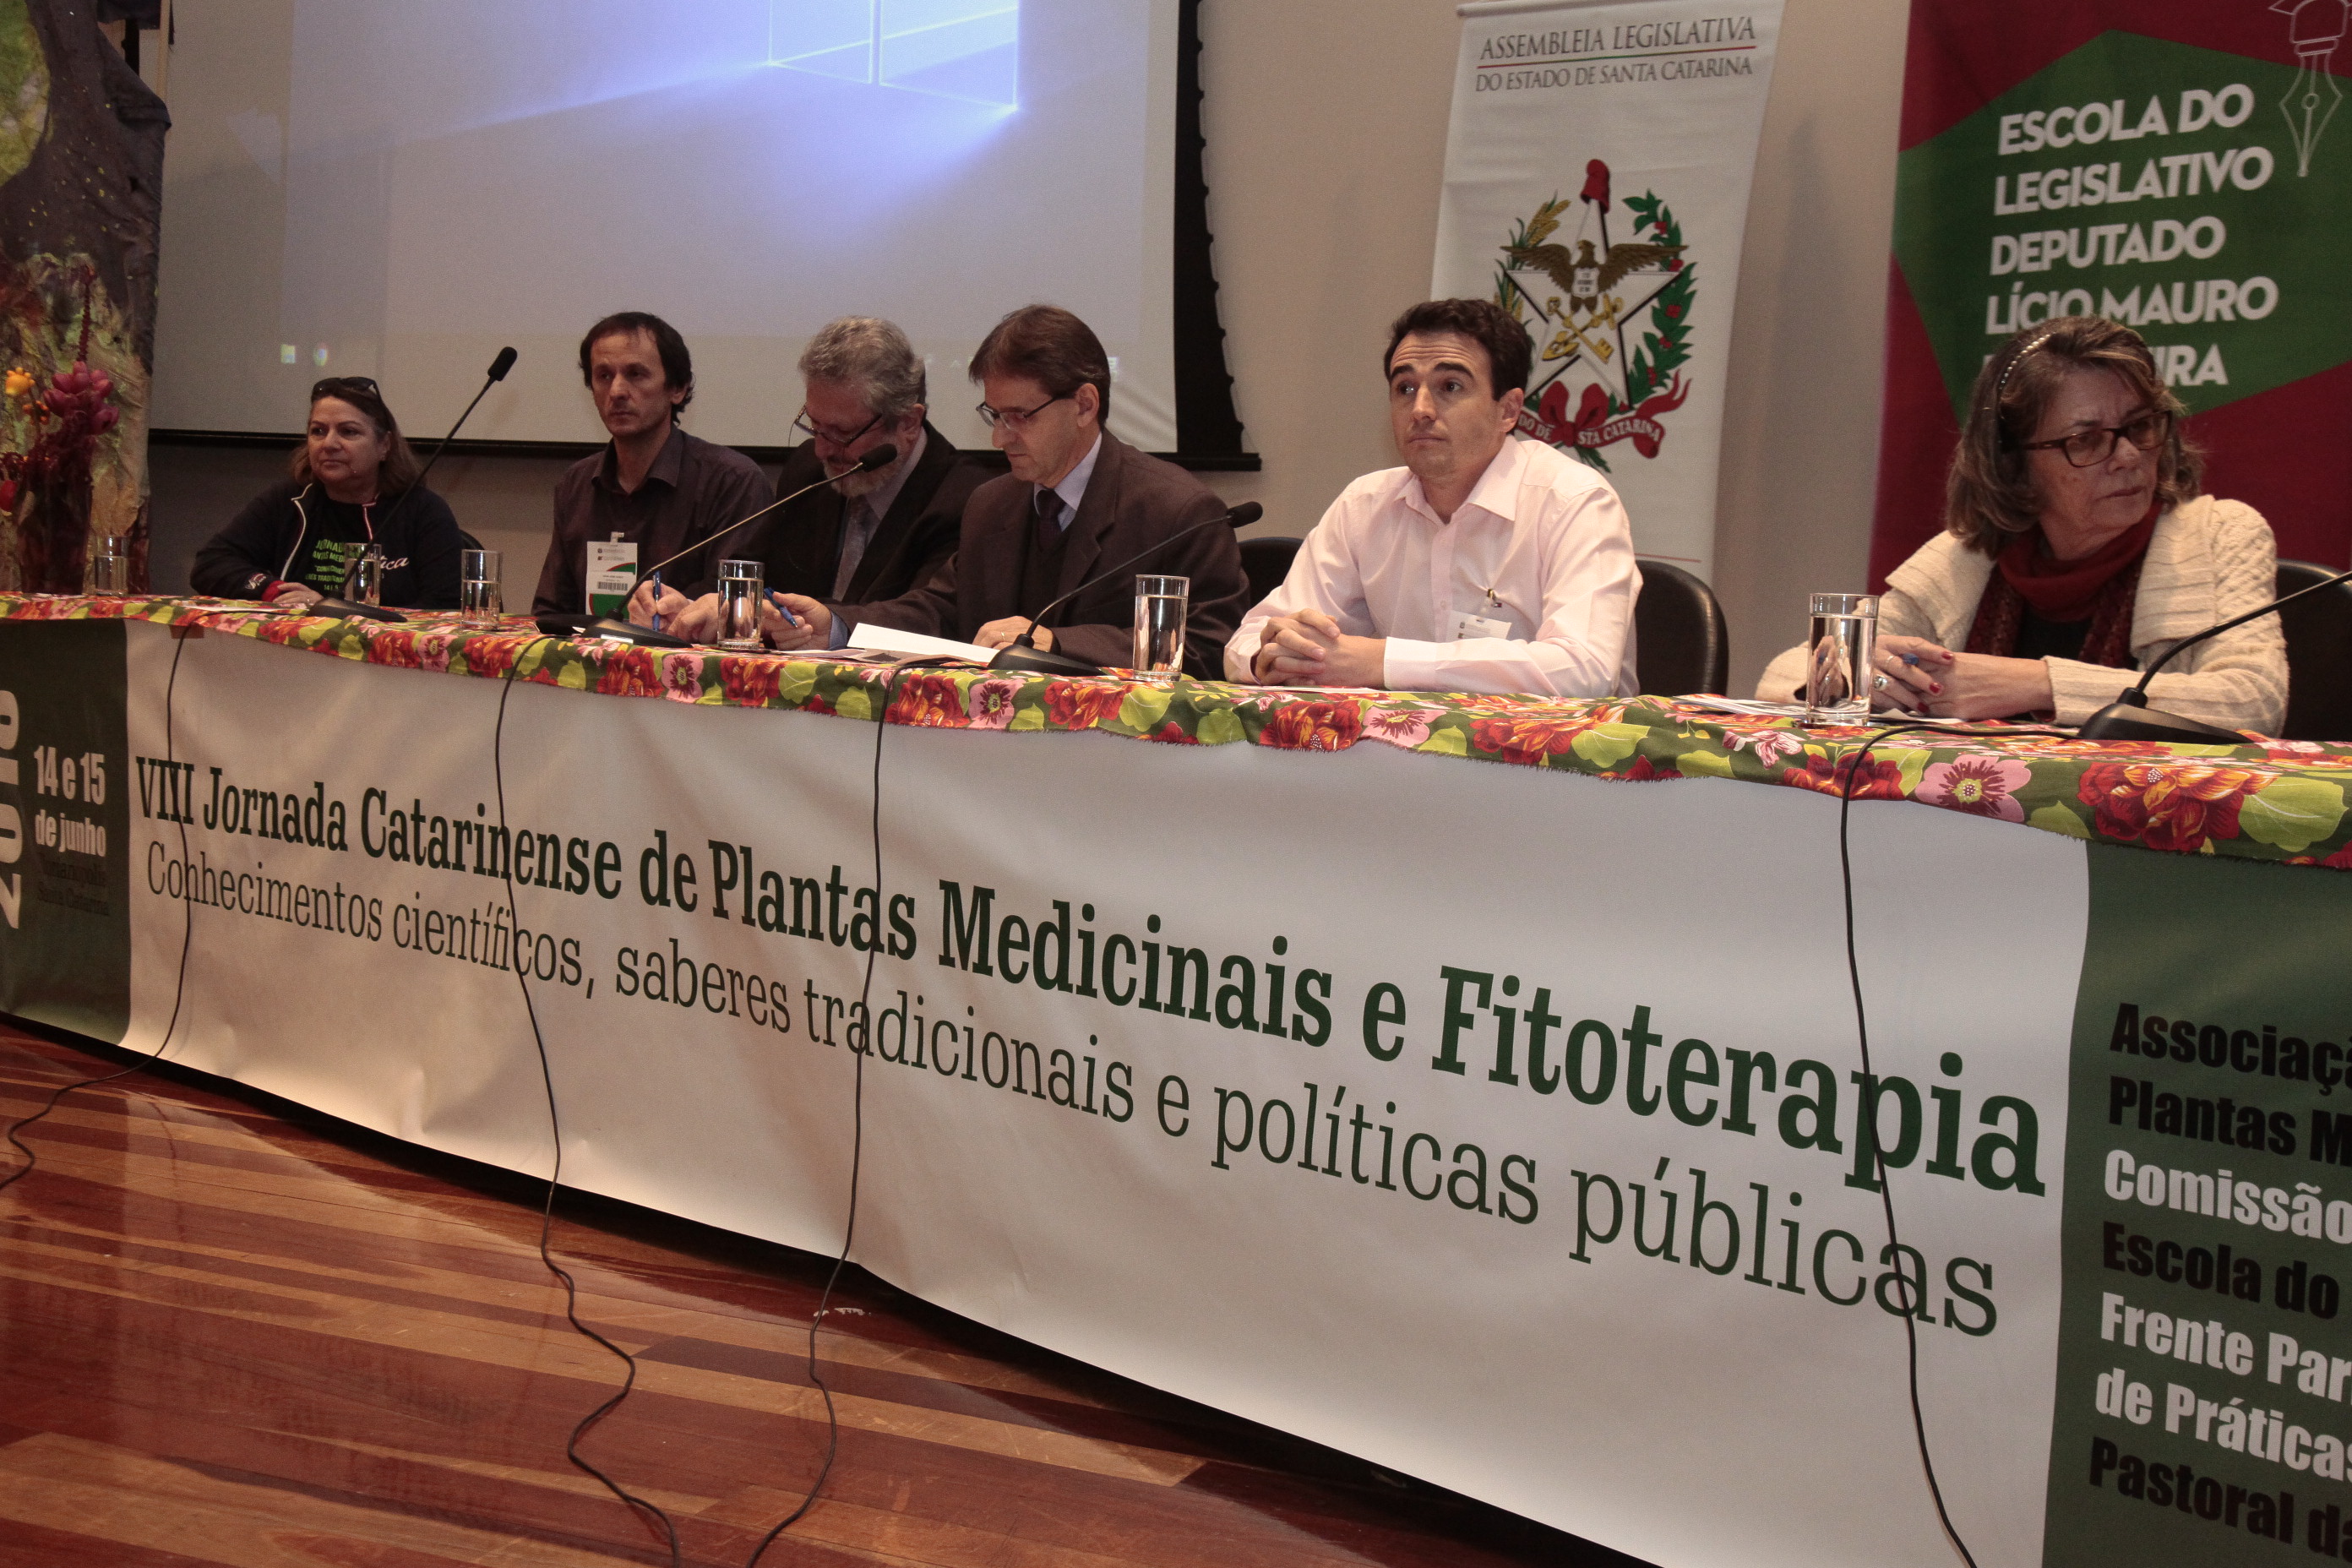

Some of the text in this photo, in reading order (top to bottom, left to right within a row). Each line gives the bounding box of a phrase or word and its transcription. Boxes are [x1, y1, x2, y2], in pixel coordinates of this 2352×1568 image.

[1476, 56, 1754, 91] DO ESTADO DE SANTA CATARINA
[1480, 16, 1756, 60] ASSEMBLEIA LEGISLATIVA
[1997, 84, 2256, 155] ESCOLA DO
[1994, 146, 2275, 216] LEGISLATIVO
[1990, 215, 2227, 276] DEPUTADO
[2101, 276, 2279, 326] MAURO
[33, 745, 106, 806] 14 e 15
[35, 808, 107, 858] de junho
[135, 756, 2046, 1198] VIII Jornada Catarinense de Plantas Medicinais e Fitoterapia
[148, 841, 1997, 1337] Conhecimentos científicos, saberes tradicionais e políticas públicas
[2110, 1002, 2352, 1097] Associaç
[2108, 1075, 2297, 1157] Plantas
[2104, 1149, 2352, 1245] Comissão
[2102, 1221, 2339, 1320] Escola do
[2100, 1291, 2254, 1376] Frente
[2095, 1367, 2352, 1484] de Prática
[2088, 1435, 2295, 1546] Pastoral
